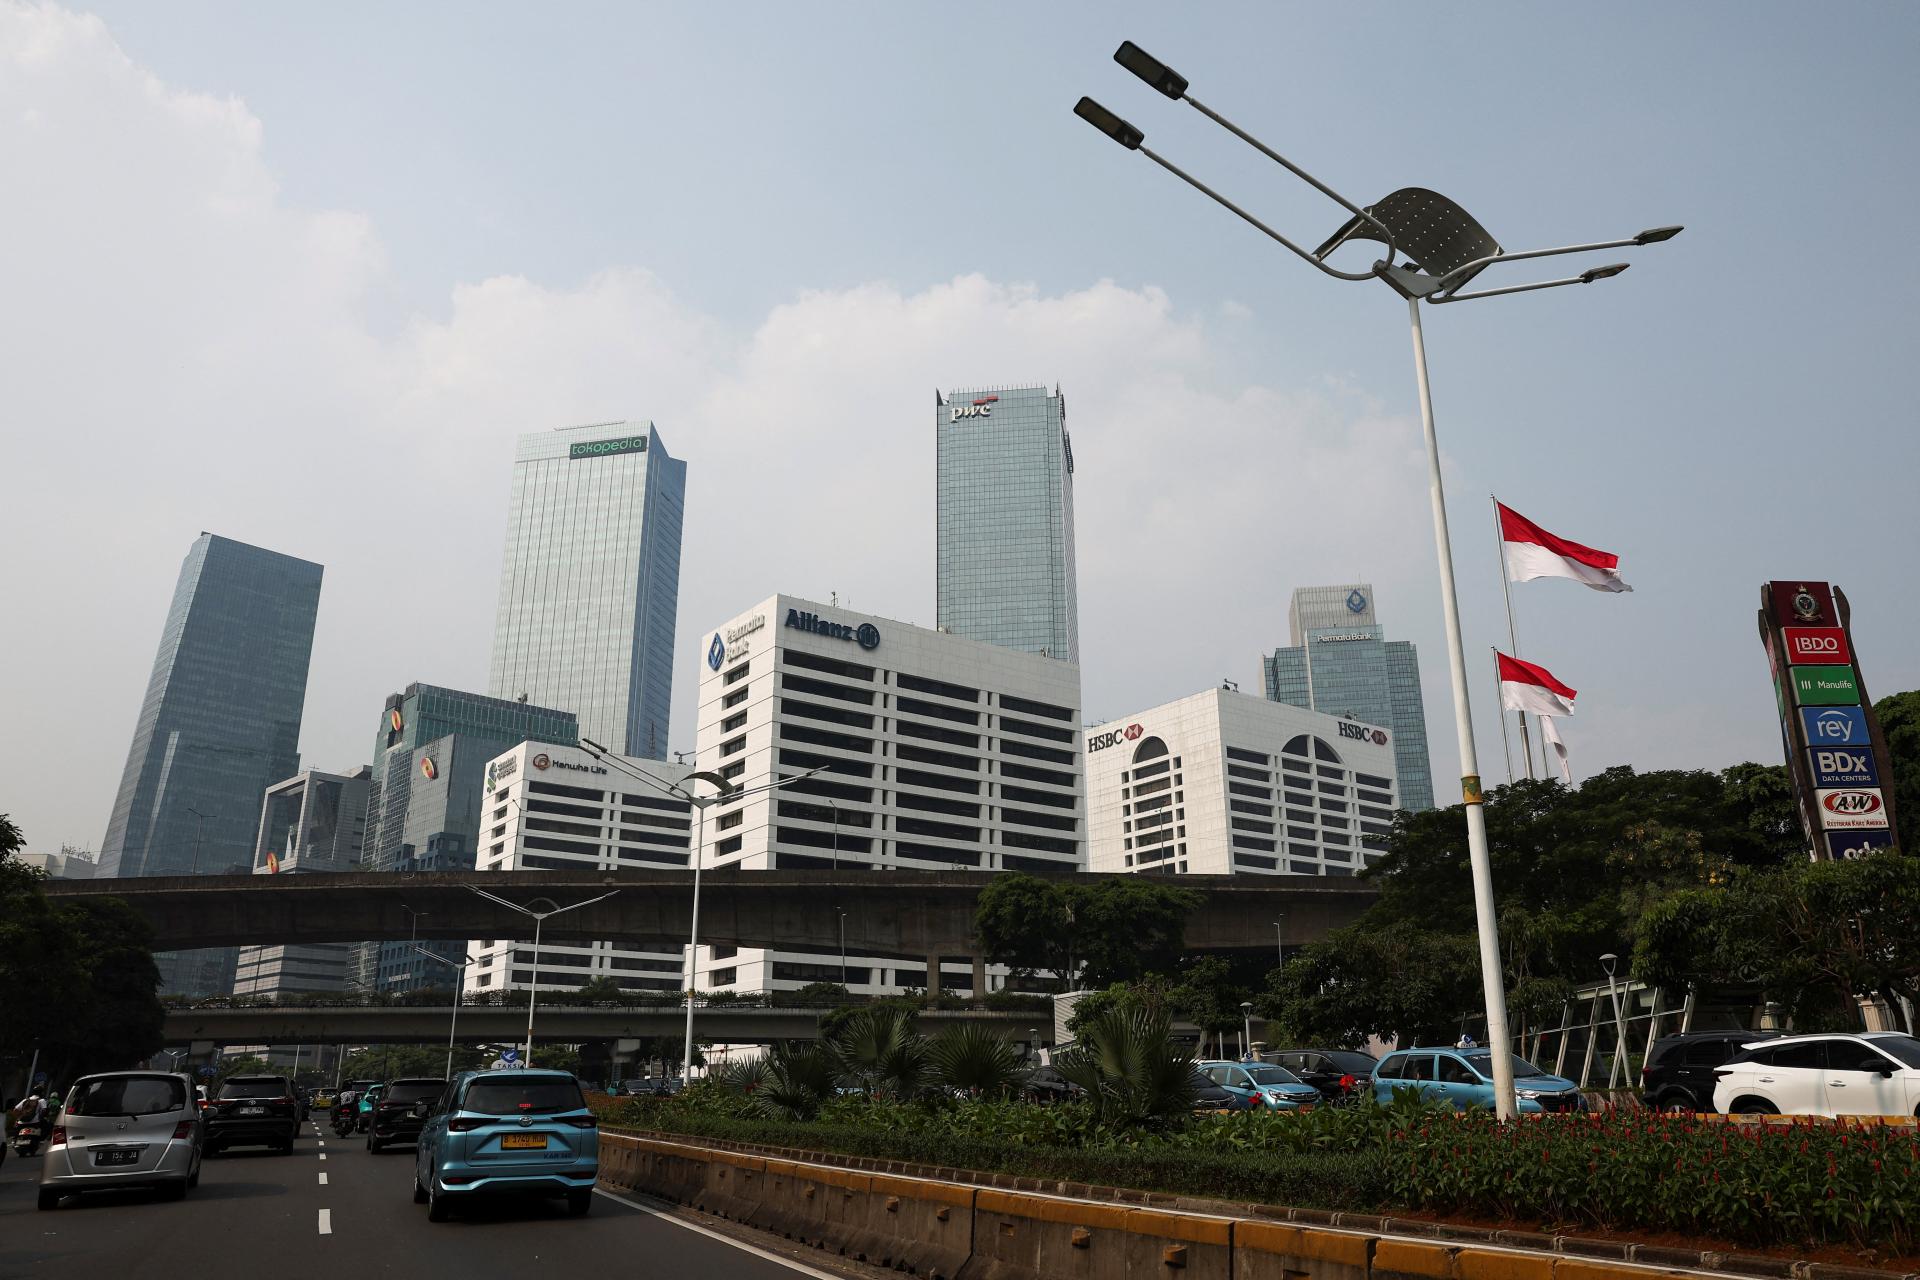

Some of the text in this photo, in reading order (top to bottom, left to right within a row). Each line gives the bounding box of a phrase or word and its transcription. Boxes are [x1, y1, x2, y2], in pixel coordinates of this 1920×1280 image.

[950, 403, 991, 423] pwc
[572, 438, 642, 455] tokopedia
[785, 609, 852, 641] Allianz
[1800, 637, 1838, 650] BDO
[1817, 680, 1853, 690] Manulife
[1088, 728, 1123, 753] HSBC
[1338, 721, 1371, 742] HSBC
[1817, 720, 1853, 742] rey
[552, 760, 608, 775] Hanwha Life
[1833, 792, 1871, 811] A&W
